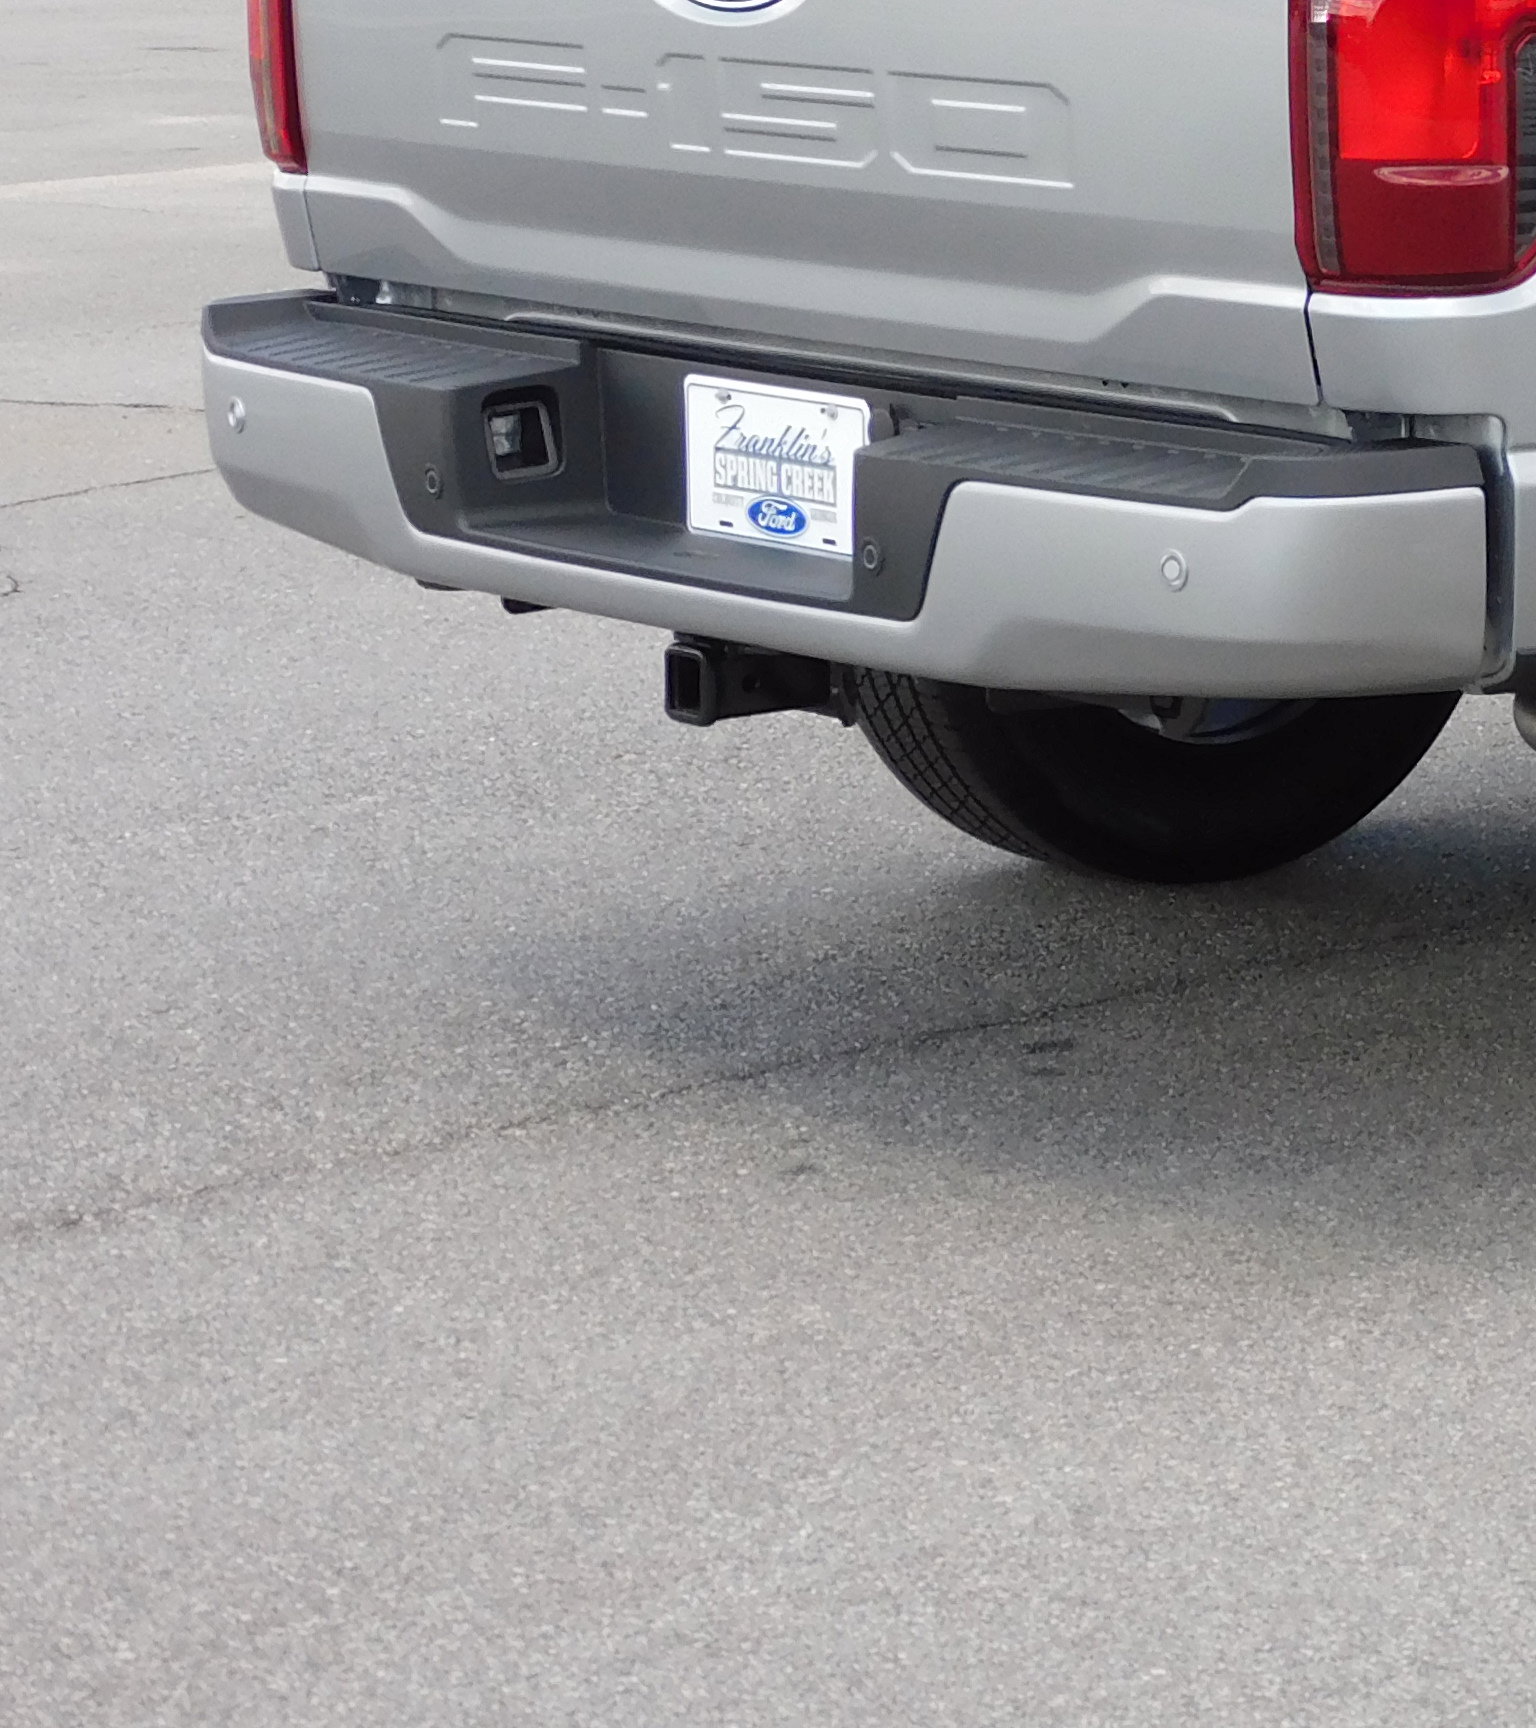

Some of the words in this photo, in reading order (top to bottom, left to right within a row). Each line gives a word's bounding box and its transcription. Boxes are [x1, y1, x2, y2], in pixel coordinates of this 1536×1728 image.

[436, 33, 1075, 190] F-150
[714, 405, 833, 464] Franklin's
[715, 453, 777, 493] SPRING
[781, 466, 835, 503] CREEK
[758, 500, 796, 531] Ford
